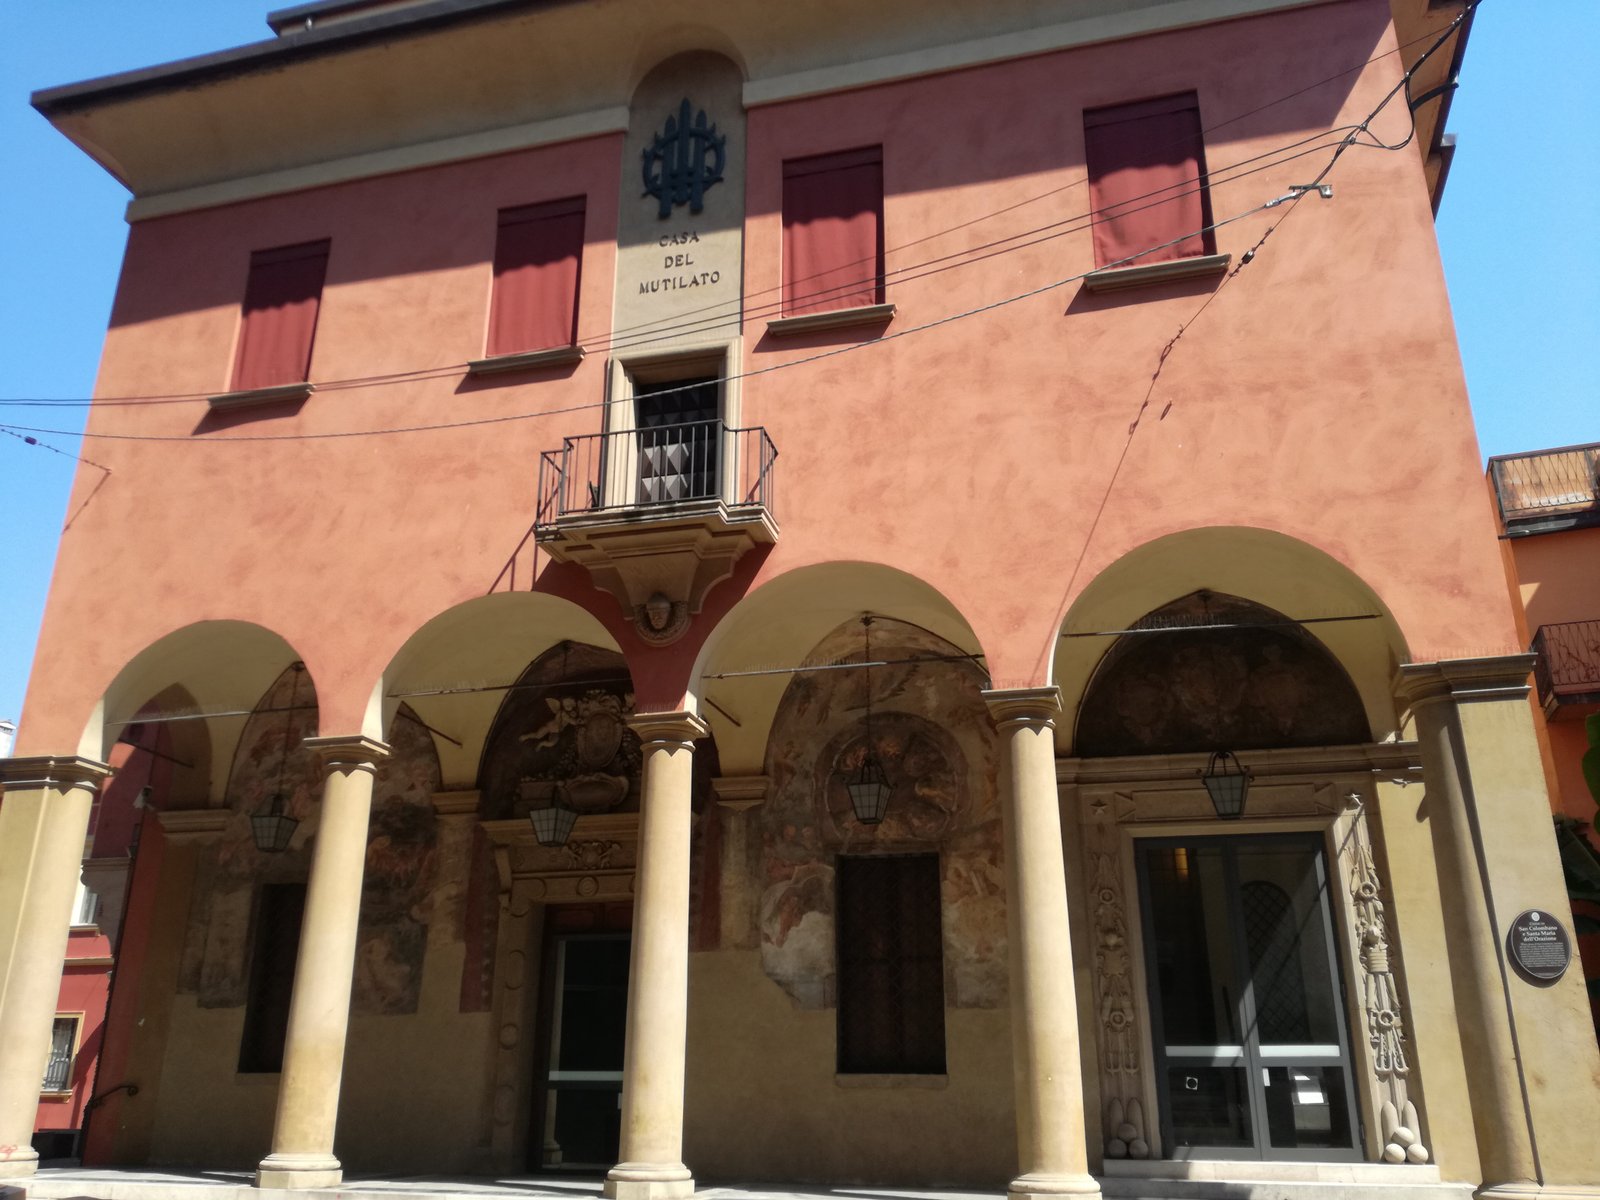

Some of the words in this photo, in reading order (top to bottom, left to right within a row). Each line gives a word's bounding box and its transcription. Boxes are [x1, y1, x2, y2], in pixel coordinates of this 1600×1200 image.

[659, 231, 700, 247] CASA
[664, 253, 694, 269] DEL
[639, 271, 720, 294] MUTILATO
